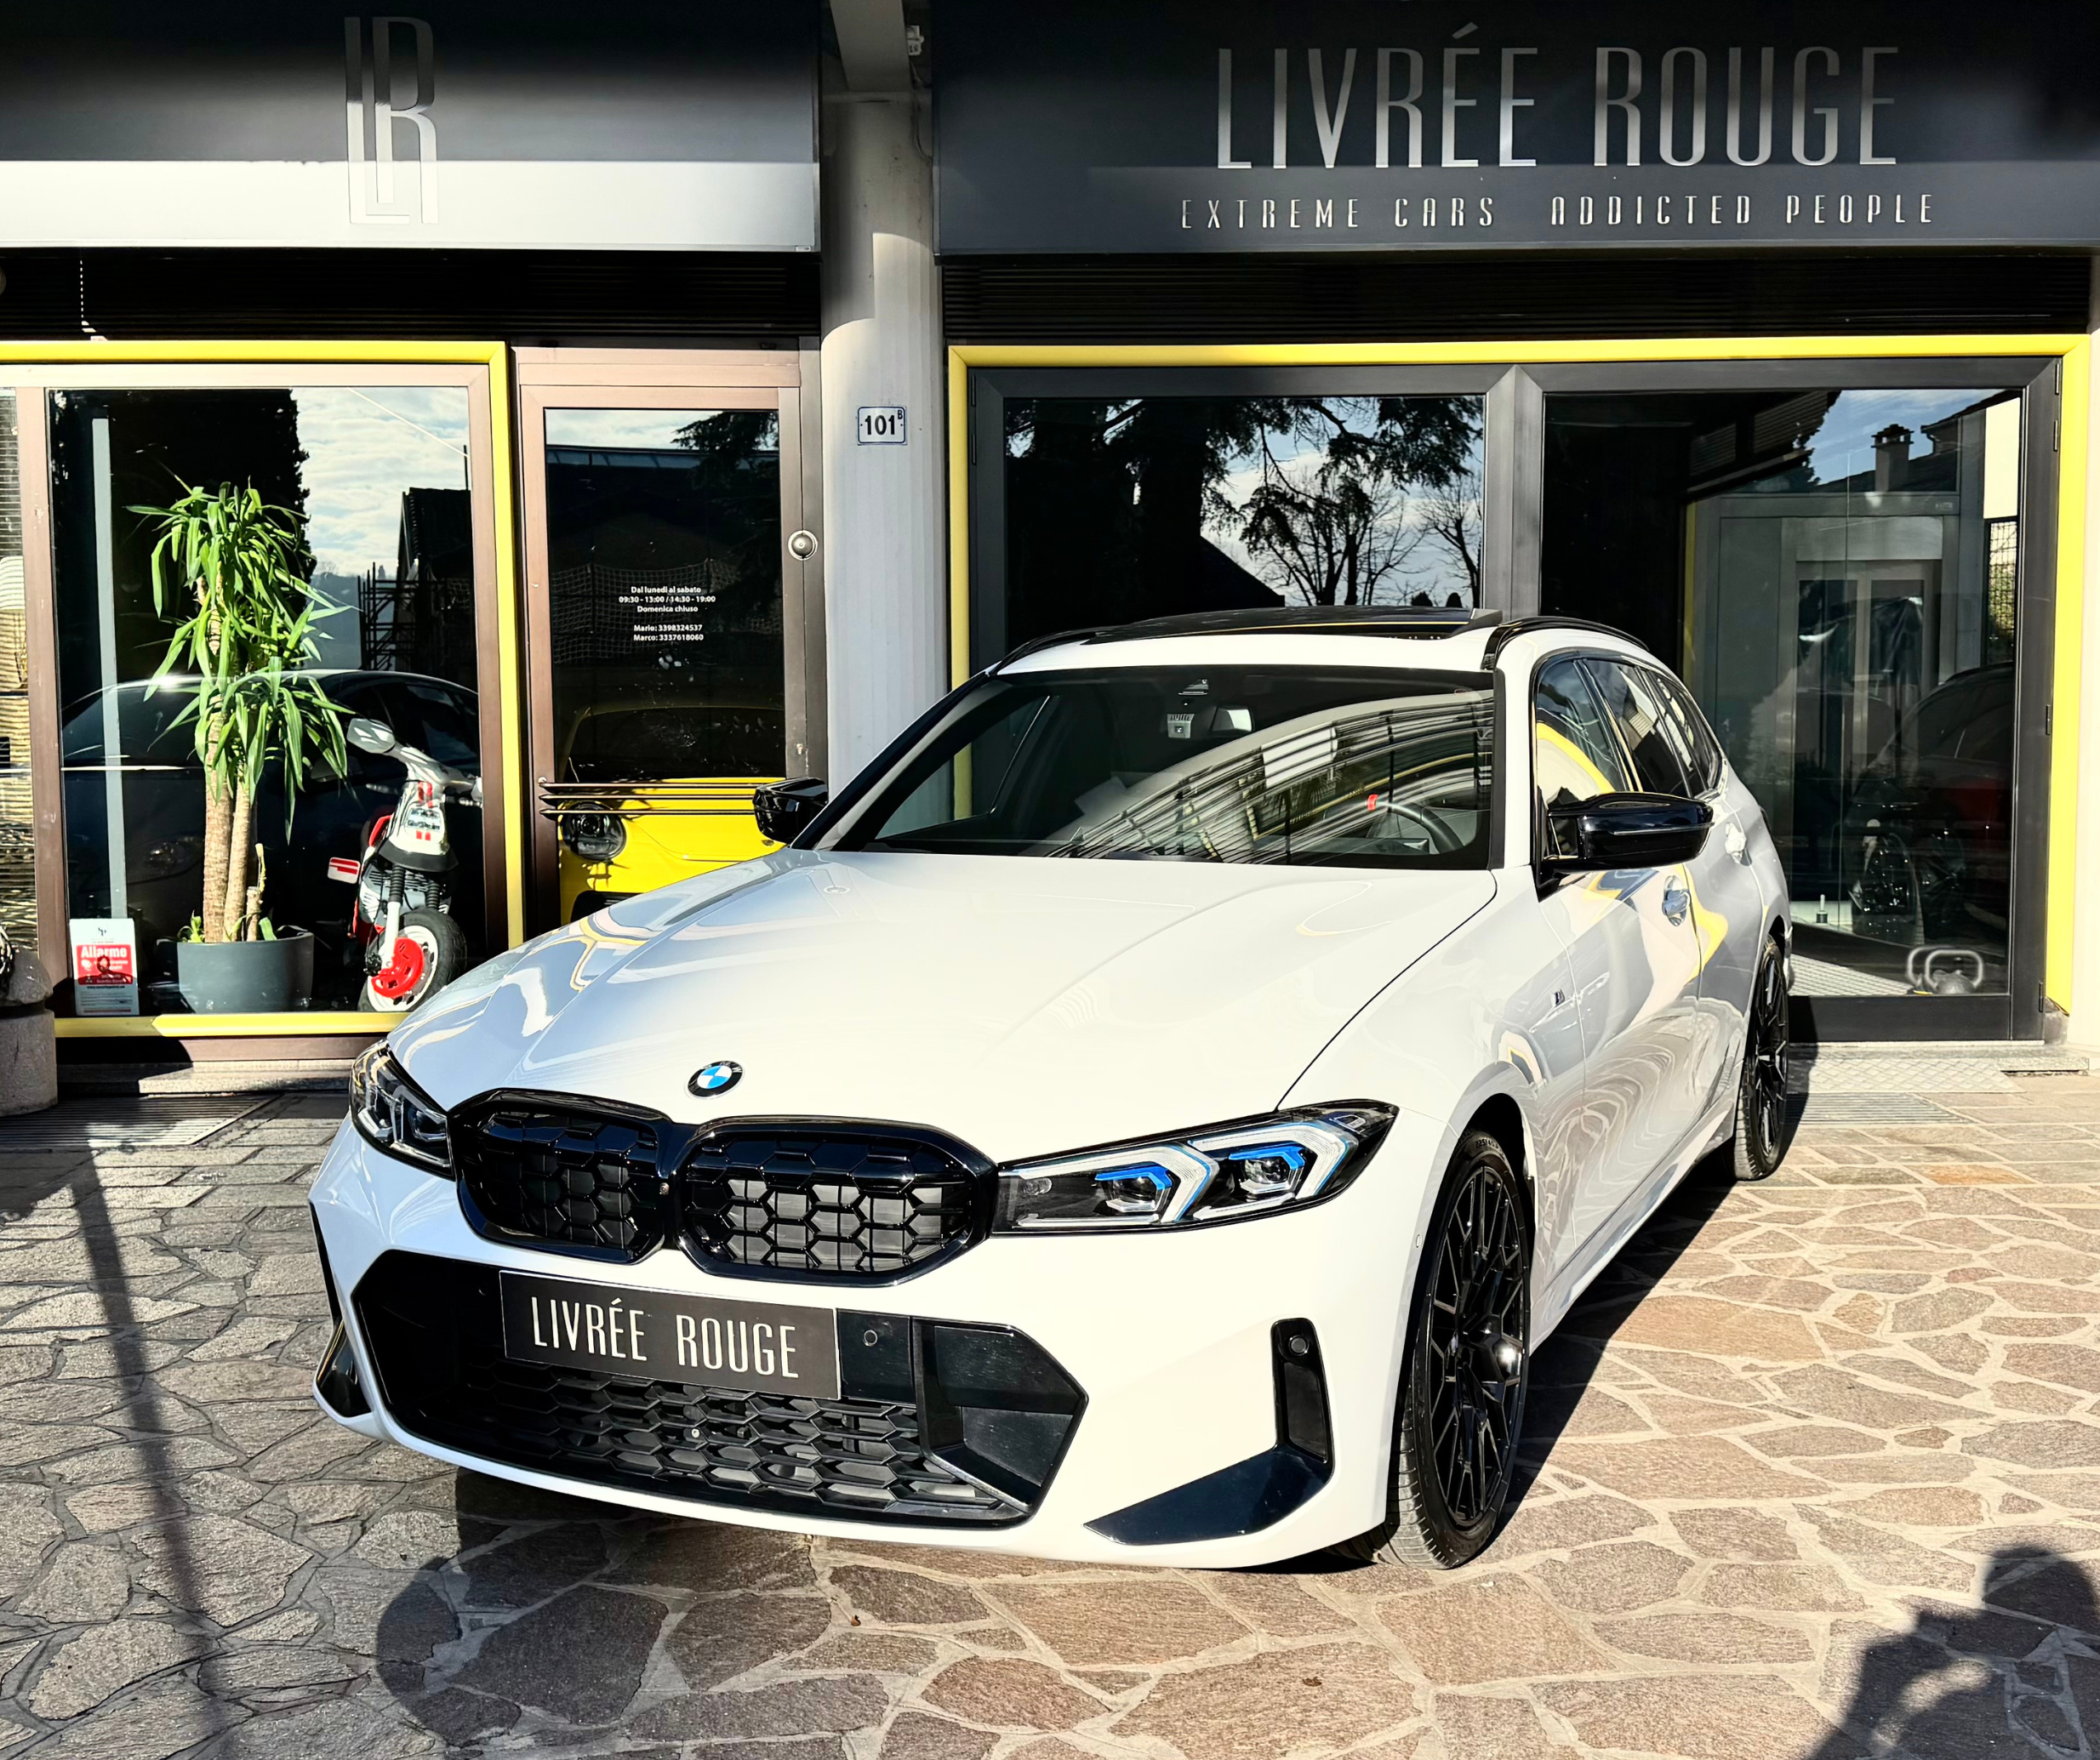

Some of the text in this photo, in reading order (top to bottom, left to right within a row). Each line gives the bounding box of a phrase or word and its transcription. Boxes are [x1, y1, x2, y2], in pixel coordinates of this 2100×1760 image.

[1218, 22, 1899, 169] LIVRÉE ROUGE
[1181, 193, 1932, 230] EXTREME CARS ADDICTED PEOPLE
[631, 585, 644, 594] Dal
[668, 585, 676, 594] al
[676, 585, 702, 594] sabato
[81, 945, 127, 958] Allarme
[531, 1297, 799, 1379] LIVRÉE ROUGE
